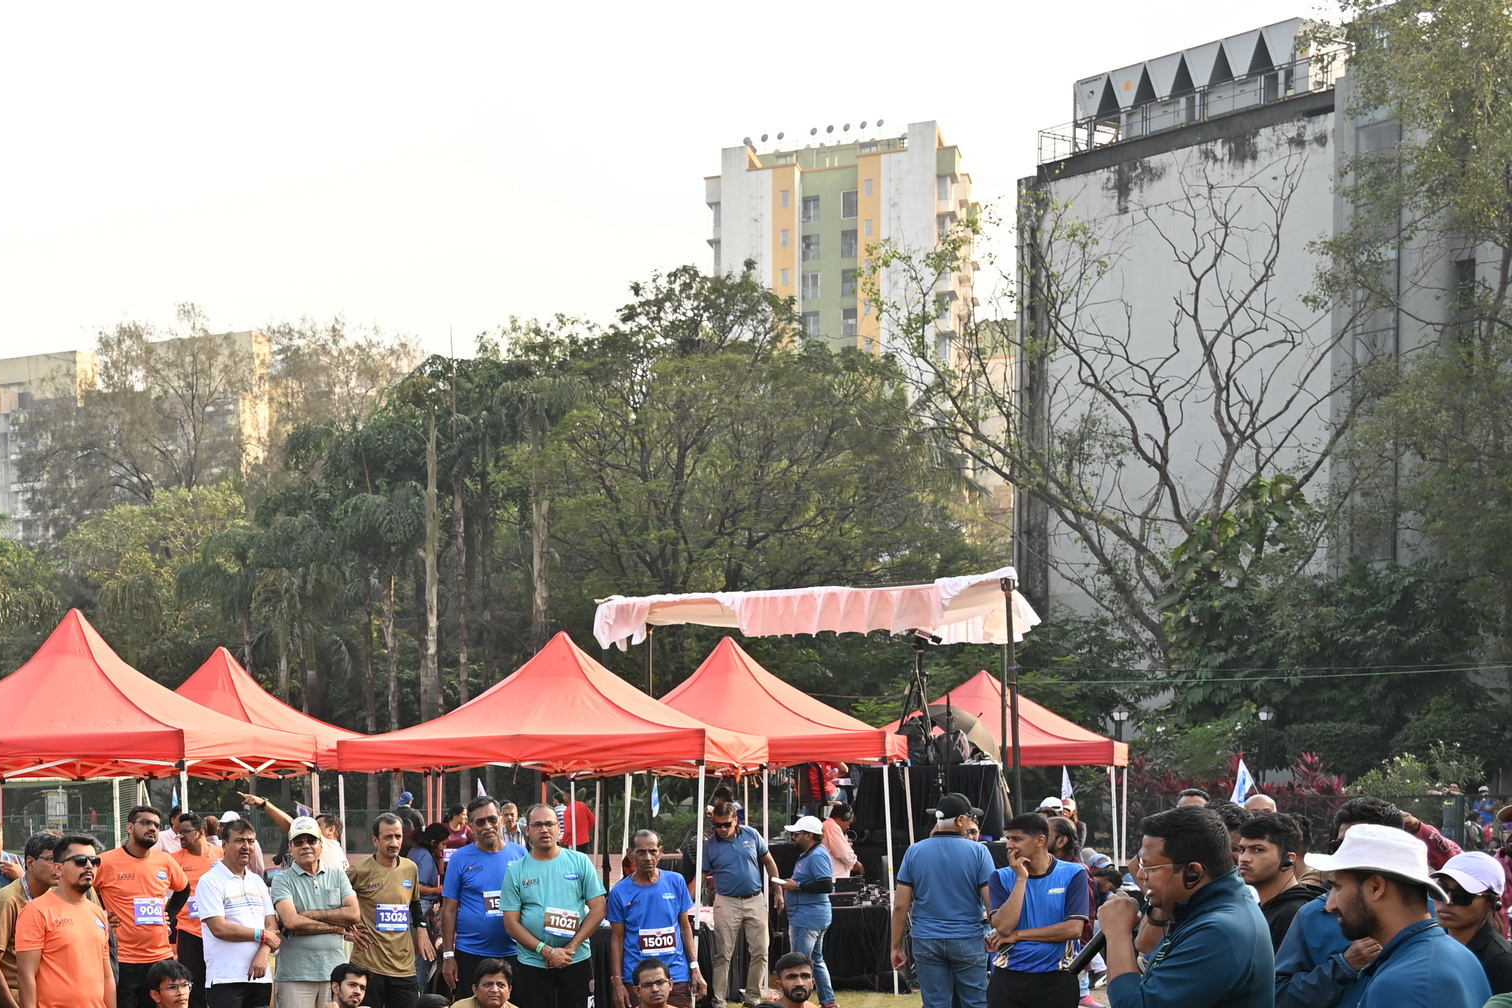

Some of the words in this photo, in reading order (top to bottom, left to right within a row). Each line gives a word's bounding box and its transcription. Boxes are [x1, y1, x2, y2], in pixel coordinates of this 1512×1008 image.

[380, 912, 408, 923] 13024
[550, 915, 577, 930] 11021
[643, 935, 674, 948] 15010
